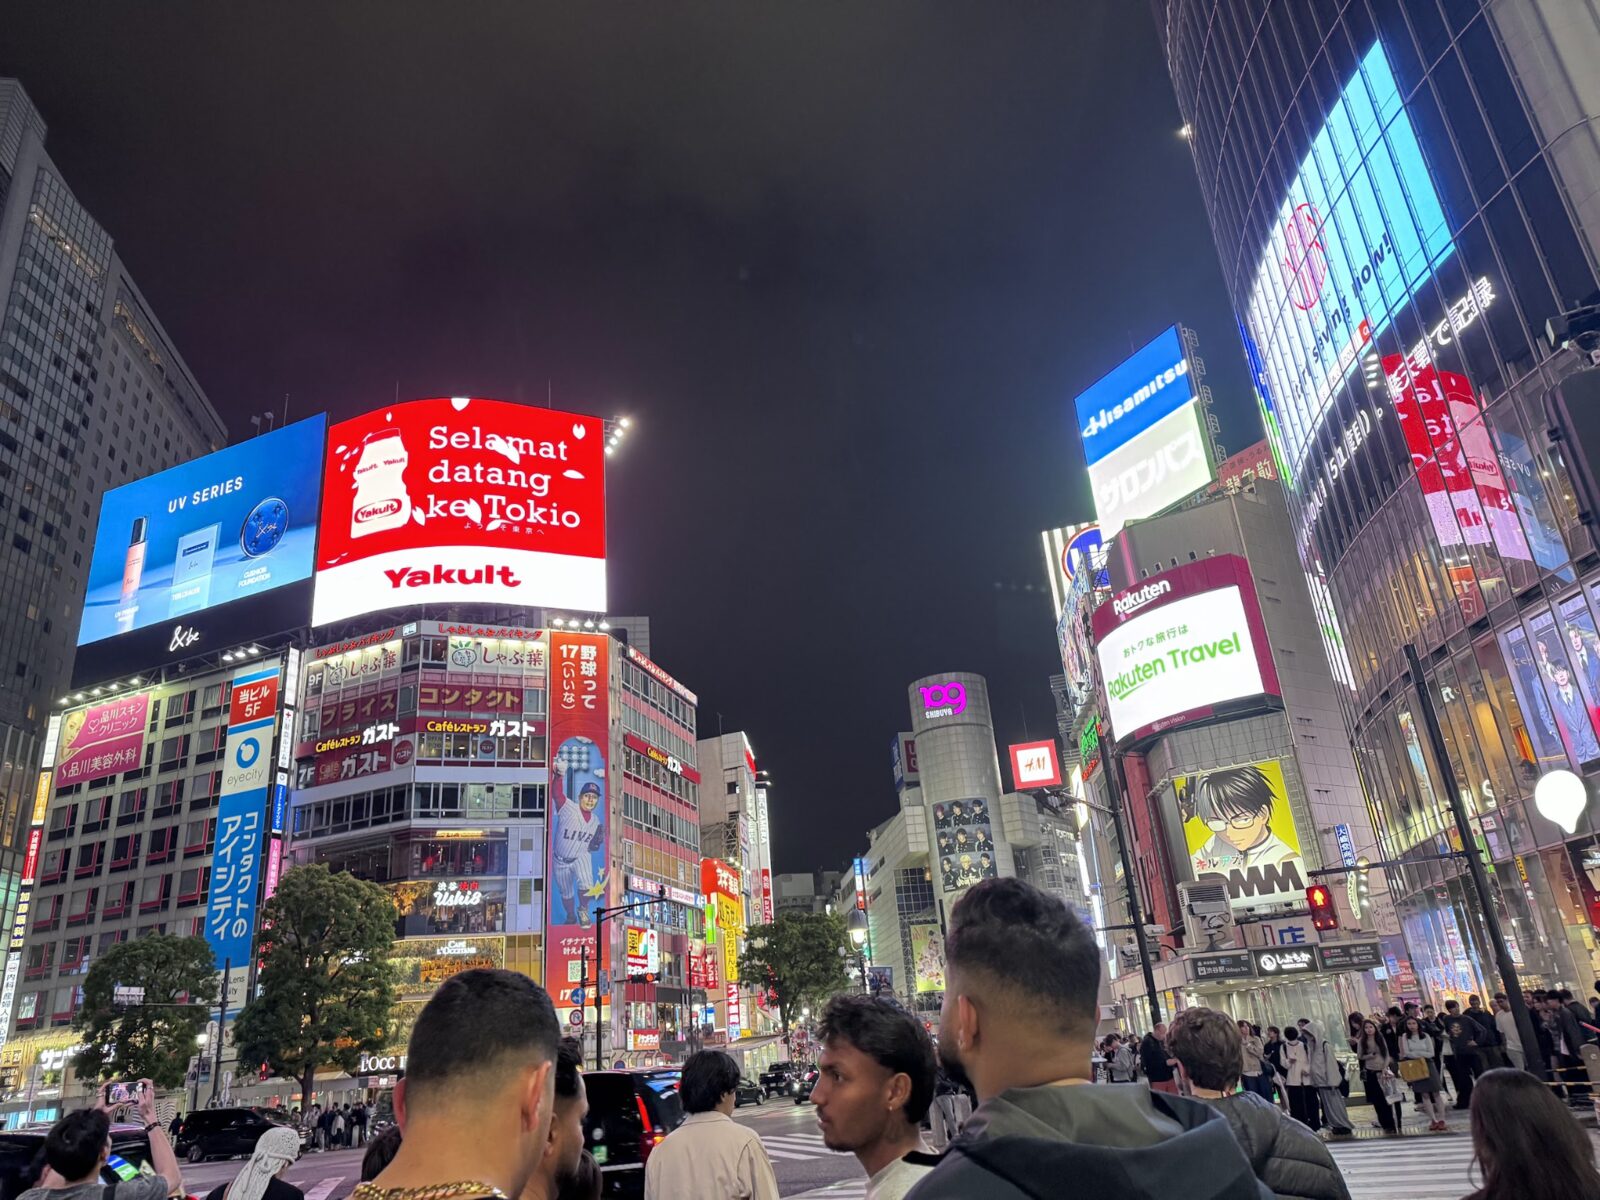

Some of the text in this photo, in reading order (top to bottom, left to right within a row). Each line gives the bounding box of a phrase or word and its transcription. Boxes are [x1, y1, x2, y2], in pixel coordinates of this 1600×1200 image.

[1082, 359, 1188, 438] Hisamitsu
[429, 425, 568, 461] Selamat
[428, 459, 552, 497] datang
[168, 476, 243, 514] UV SERIES
[360, 503, 396, 519] Yakult
[425, 494, 581, 528] ke Tokio
[463, 521, 545, 535] ようそ東京へ
[384, 564, 522, 589] Yakult
[1113, 579, 1171, 616] Rakuten
[1123, 624, 1189, 659] おトクな旅行は
[350, 650, 397, 677] しゃぶ葉
[483, 647, 543, 667] しゃぶ葉
[1108, 631, 1241, 701] Rakuten Travel
[308, 673, 322, 686] 9F
[580, 645, 597, 710] 野球って
[239, 685, 270, 704] 当ビル
[420, 688, 520, 708] コンタクト
[920, 681, 967, 715] 109
[100, 703, 145, 723] 品川スキン
[245, 702, 261, 718] 5F
[925, 708, 953, 719] SHIBUYA
[98, 717, 138, 736] クリニック
[362, 722, 400, 745] ガスト
[427, 720, 536, 737] Caféレストラン ガスト
[67, 747, 137, 777] 品川美容外科
[341, 751, 387, 779] ガスト
[227, 768, 263, 785] eyecity
[299, 767, 315, 783] 7F
[563, 828, 593, 844] LIVE
[211, 814, 243, 941] アイシティ
[232, 811, 259, 938] コンタクトの
[433, 890, 482, 906] Ushi8
